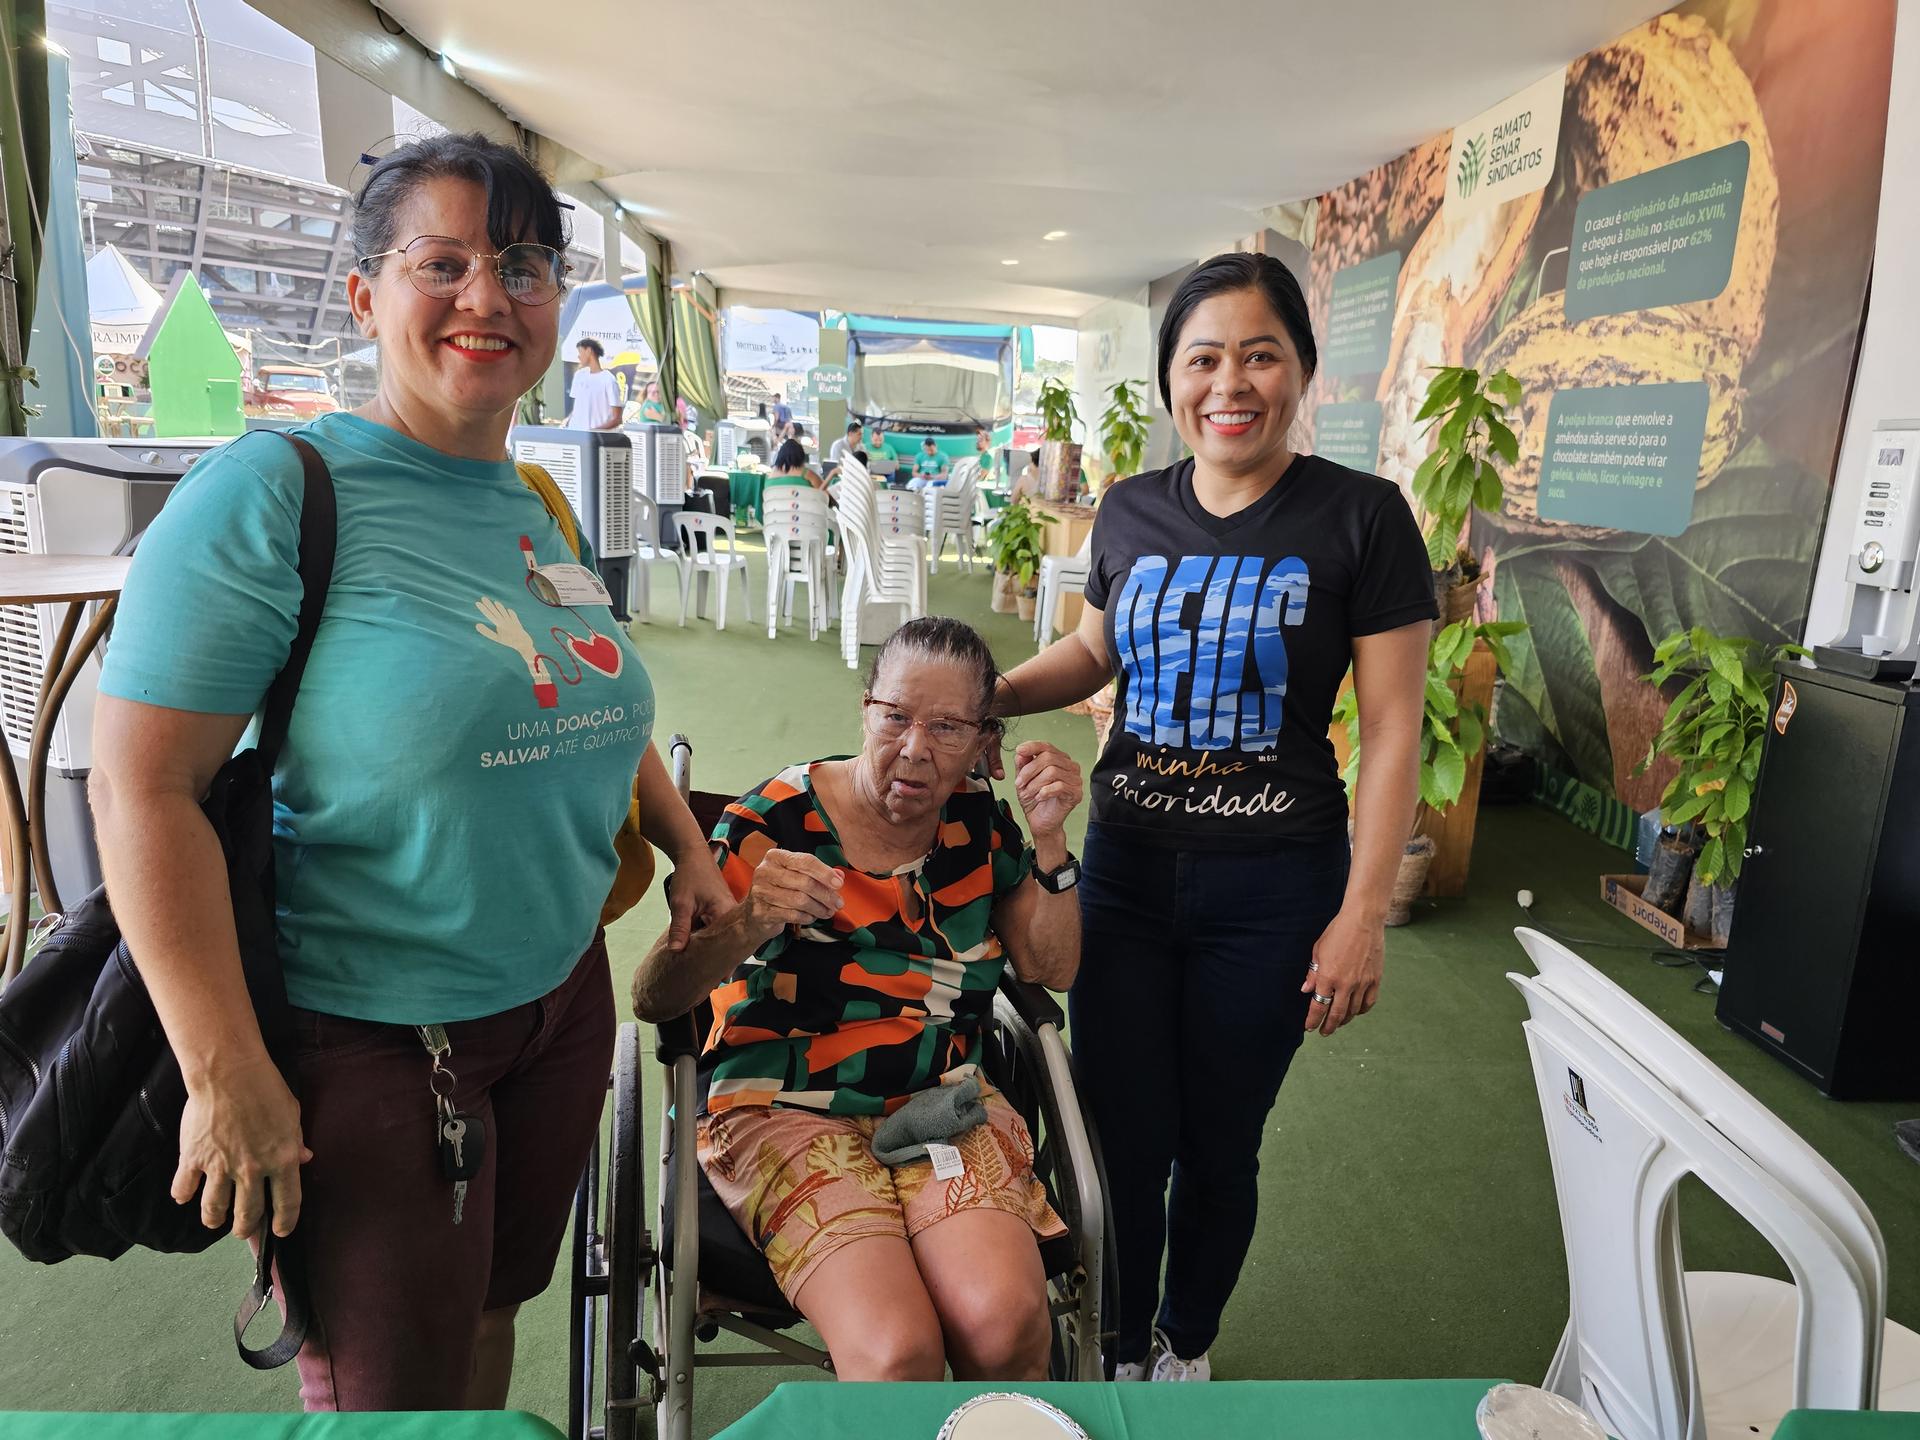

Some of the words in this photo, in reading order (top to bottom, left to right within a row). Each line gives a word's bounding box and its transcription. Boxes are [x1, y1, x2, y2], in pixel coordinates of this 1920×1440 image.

[1492, 111, 1531, 145] FAMATO
[1486, 148, 1542, 186] SINDICATOS
[1490, 137, 1520, 165] SENAR
[1584, 220, 1592, 233] O
[1592, 216, 1614, 231] cacau
[1615, 214, 1622, 225] é
[1622, 200, 1666, 222] originário
[1667, 194, 1680, 209] da
[1681, 180, 1732, 204] Amazônia
[1582, 241, 1587, 252] e
[1588, 233, 1616, 253] chegou
[1624, 225, 1649, 241] Bahia
[1650, 223, 1663, 235] no
[1663, 214, 1695, 231] século
[1697, 203, 1727, 223] XVIII,
[1579, 258, 1594, 272] que
[1594, 252, 1612, 269] hoje
[1612, 252, 1619, 264] é
[1619, 237, 1671, 263] responsável
[1671, 236, 1689, 254] por
[1689, 228, 1712, 246] 62%
[1576, 277, 1587, 290] da
[1587, 269, 1625, 291] produção
[1626, 259, 1666, 280] nacional.
[1557, 413, 1563, 426] A
[1563, 412, 1586, 428] polpa
[1587, 412, 1613, 426] branca
[1615, 413, 1631, 428] que
[1632, 411, 1665, 426] envolve
[1666, 414, 1673, 426] a
[1555, 431, 1588, 445] amêndoa
[1589, 432, 1604, 446] não
[1604, 434, 1627, 446] serve
[1628, 433, 1638, 446] só
[1639, 434, 1659, 449] para
[1660, 435, 1667, 447] o
[1553, 449, 1589, 464] chocolate:
[1590, 450, 1623, 466] também
[1623, 452, 1646, 469] pode
[1647, 454, 1668, 468] virar
[1622, 474, 1655, 489] vinagre
[1656, 476, 1663, 488] e
[1114, 555, 1311, 753] DEUS
[480, 744, 551, 768] SALVAR
[553, 734, 579, 760] ATÉ
[583, 725, 640, 751] QUATRO
[507, 720, 551, 741] UMA
[1136, 747, 1252, 779] minha
[1632, 903, 1668, 938] Report
